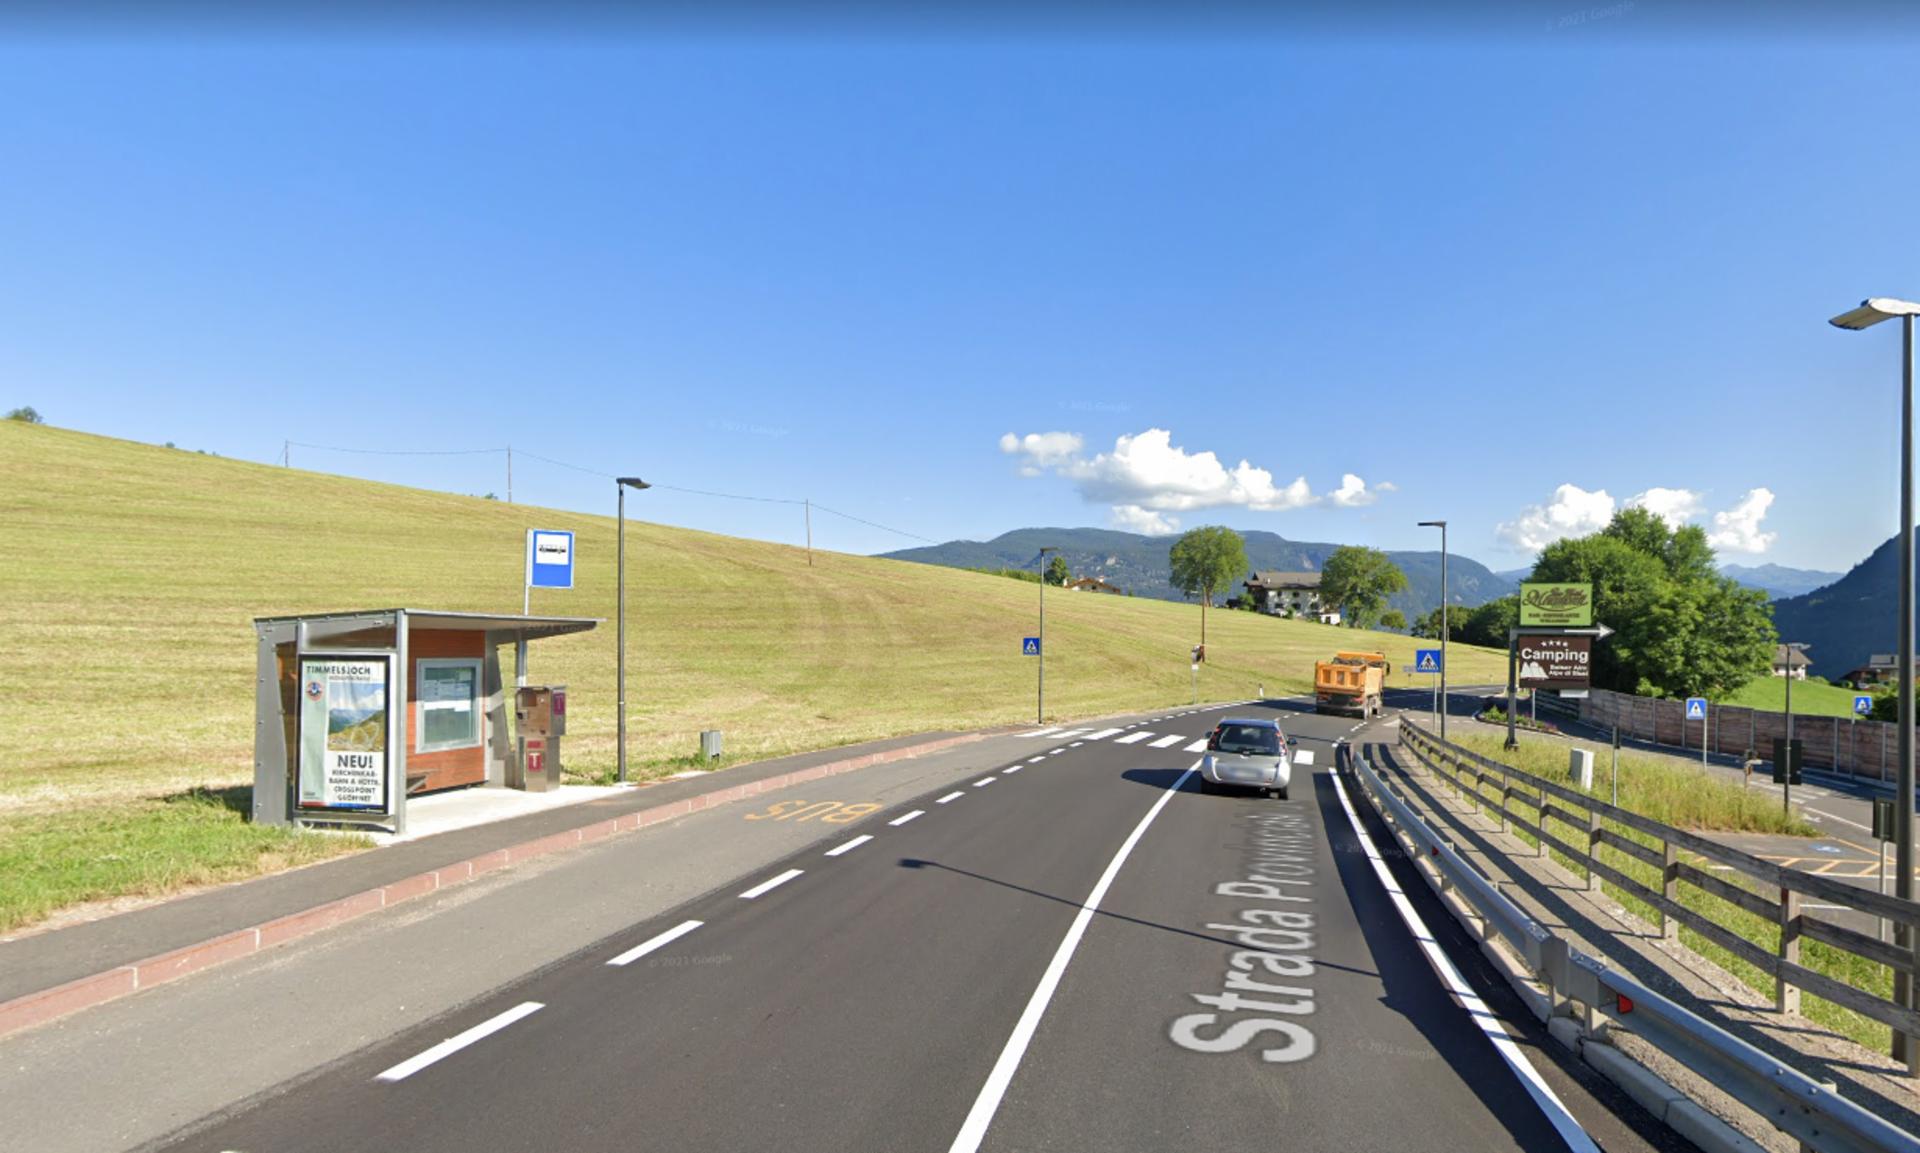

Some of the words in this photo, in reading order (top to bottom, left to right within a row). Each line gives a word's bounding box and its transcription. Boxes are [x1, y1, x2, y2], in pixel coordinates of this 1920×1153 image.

[1521, 647, 1589, 664] Camping
[306, 665, 371, 675] TIMMELSJOCH
[337, 754, 373, 769] NEU!
[528, 752, 541, 768] T
[744, 800, 884, 823] BUS
